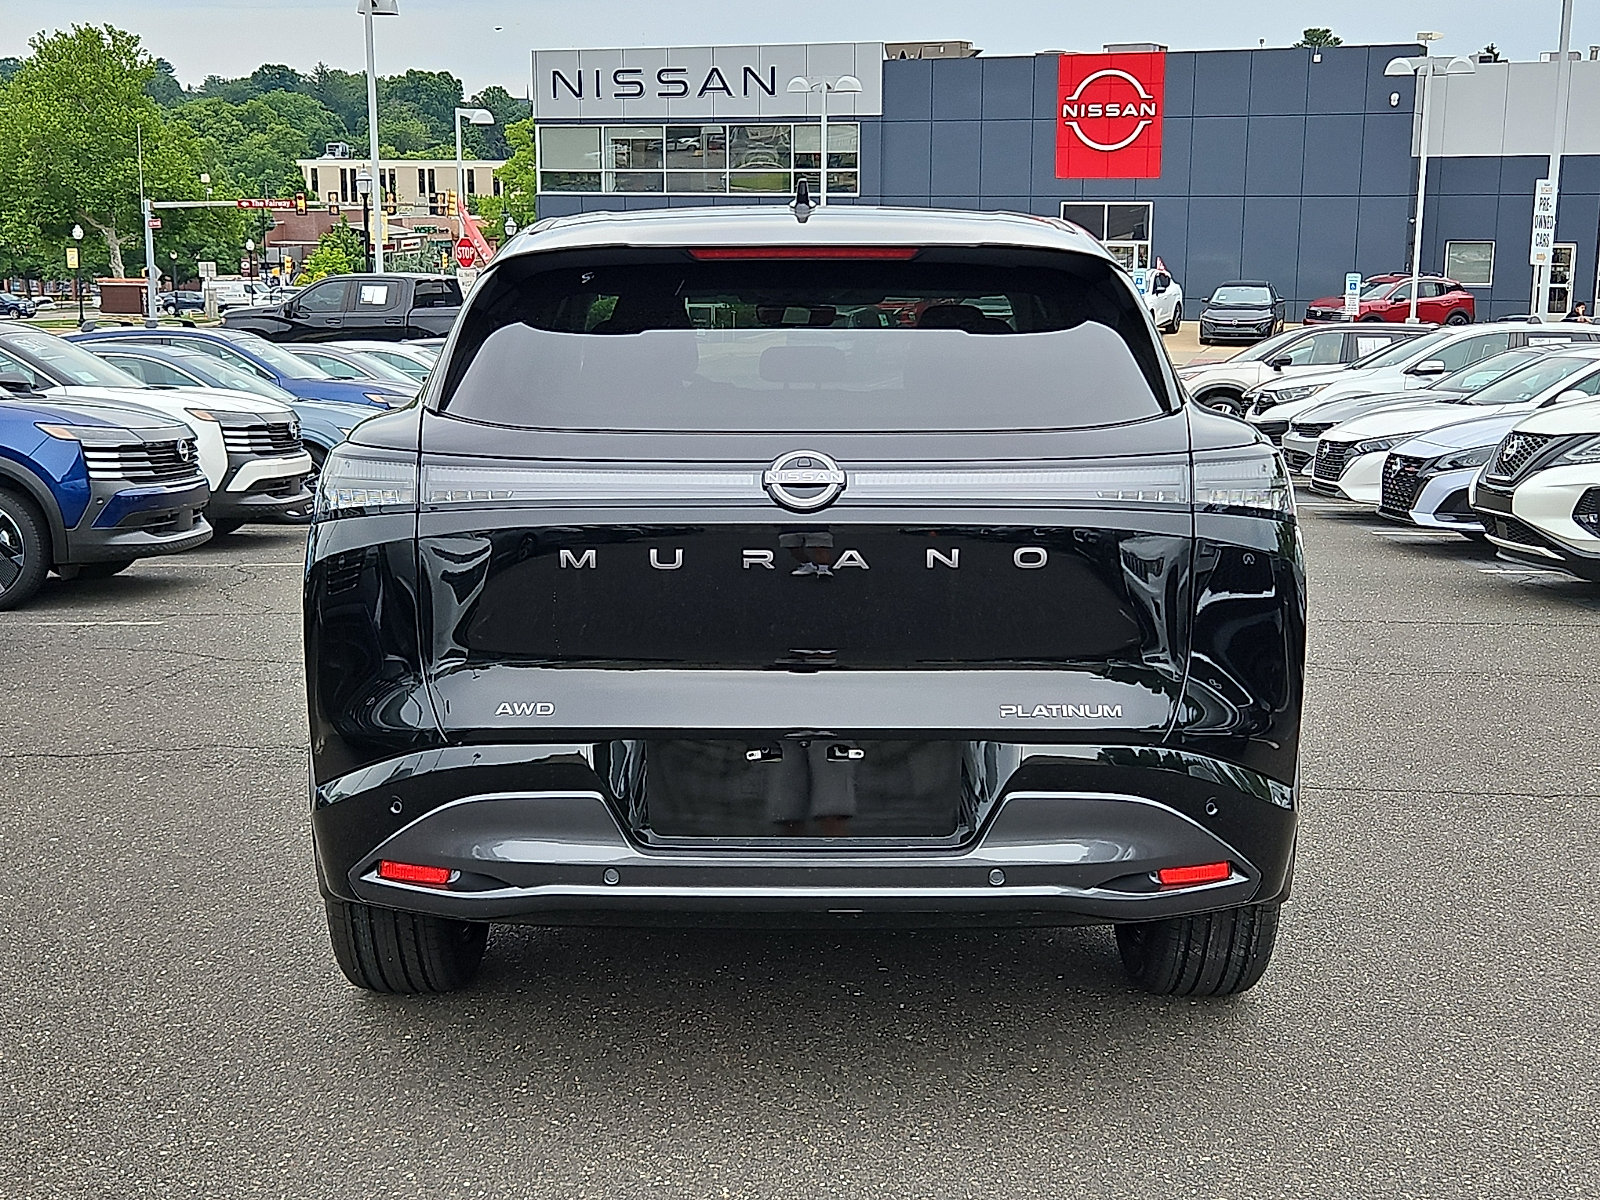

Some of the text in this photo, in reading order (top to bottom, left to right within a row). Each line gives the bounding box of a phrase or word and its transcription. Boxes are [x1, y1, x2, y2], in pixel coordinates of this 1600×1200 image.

[552, 66, 777, 99] NISSAN
[1062, 103, 1156, 117] NISSAN
[265, 200, 291, 208] Fairway
[1535, 214, 1554, 229] OWNED
[1536, 233, 1549, 247] CARS
[457, 246, 474, 259] STOP
[767, 471, 843, 481] NISSAN
[559, 547, 1048, 570] MURANO
[495, 702, 555, 716] AWD
[1000, 704, 1122, 718] PLATINUM
